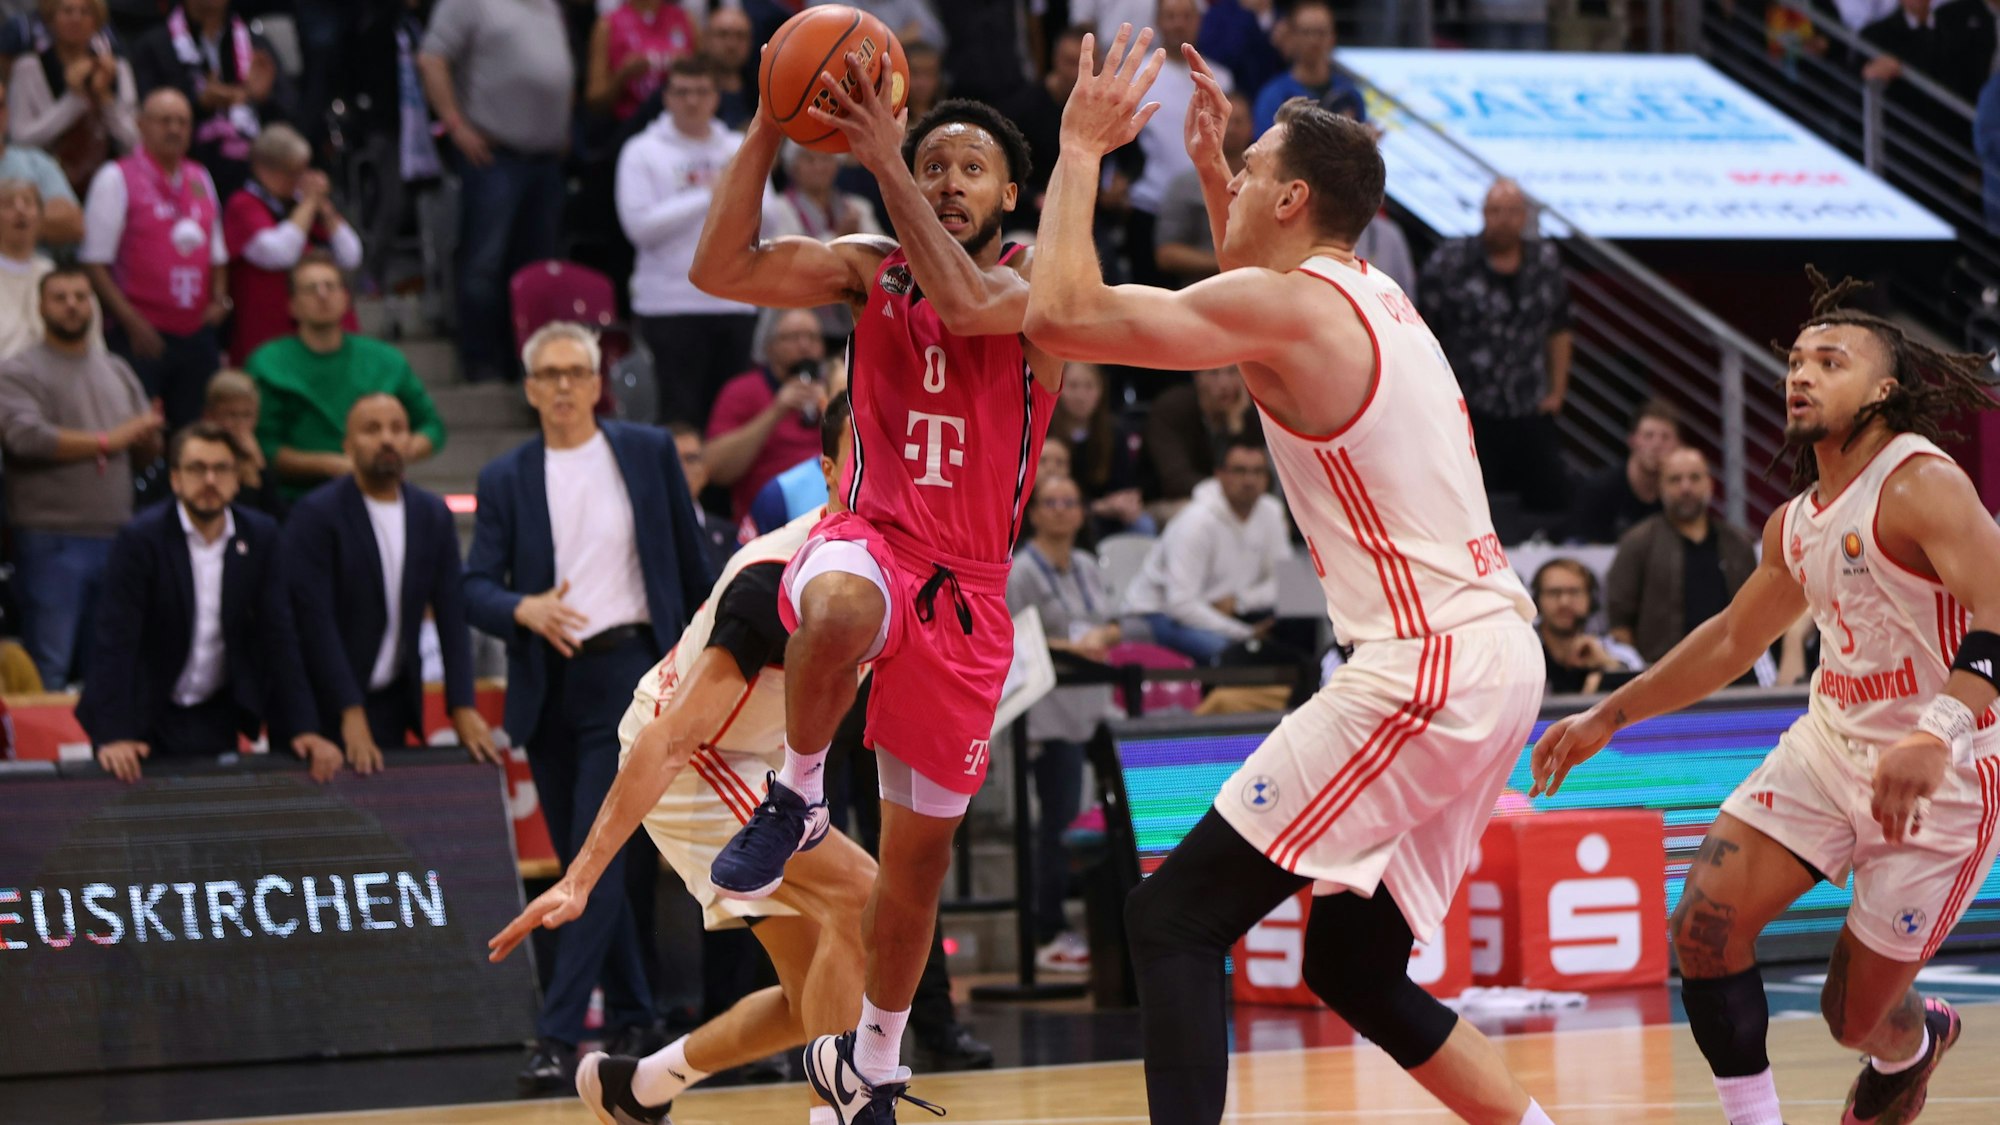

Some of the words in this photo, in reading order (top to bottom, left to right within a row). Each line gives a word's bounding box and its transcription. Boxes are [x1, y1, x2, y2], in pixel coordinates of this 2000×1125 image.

[923, 345, 946, 394] 0
[904, 409, 965, 489] T
[1818, 656, 1919, 710] iegmund
